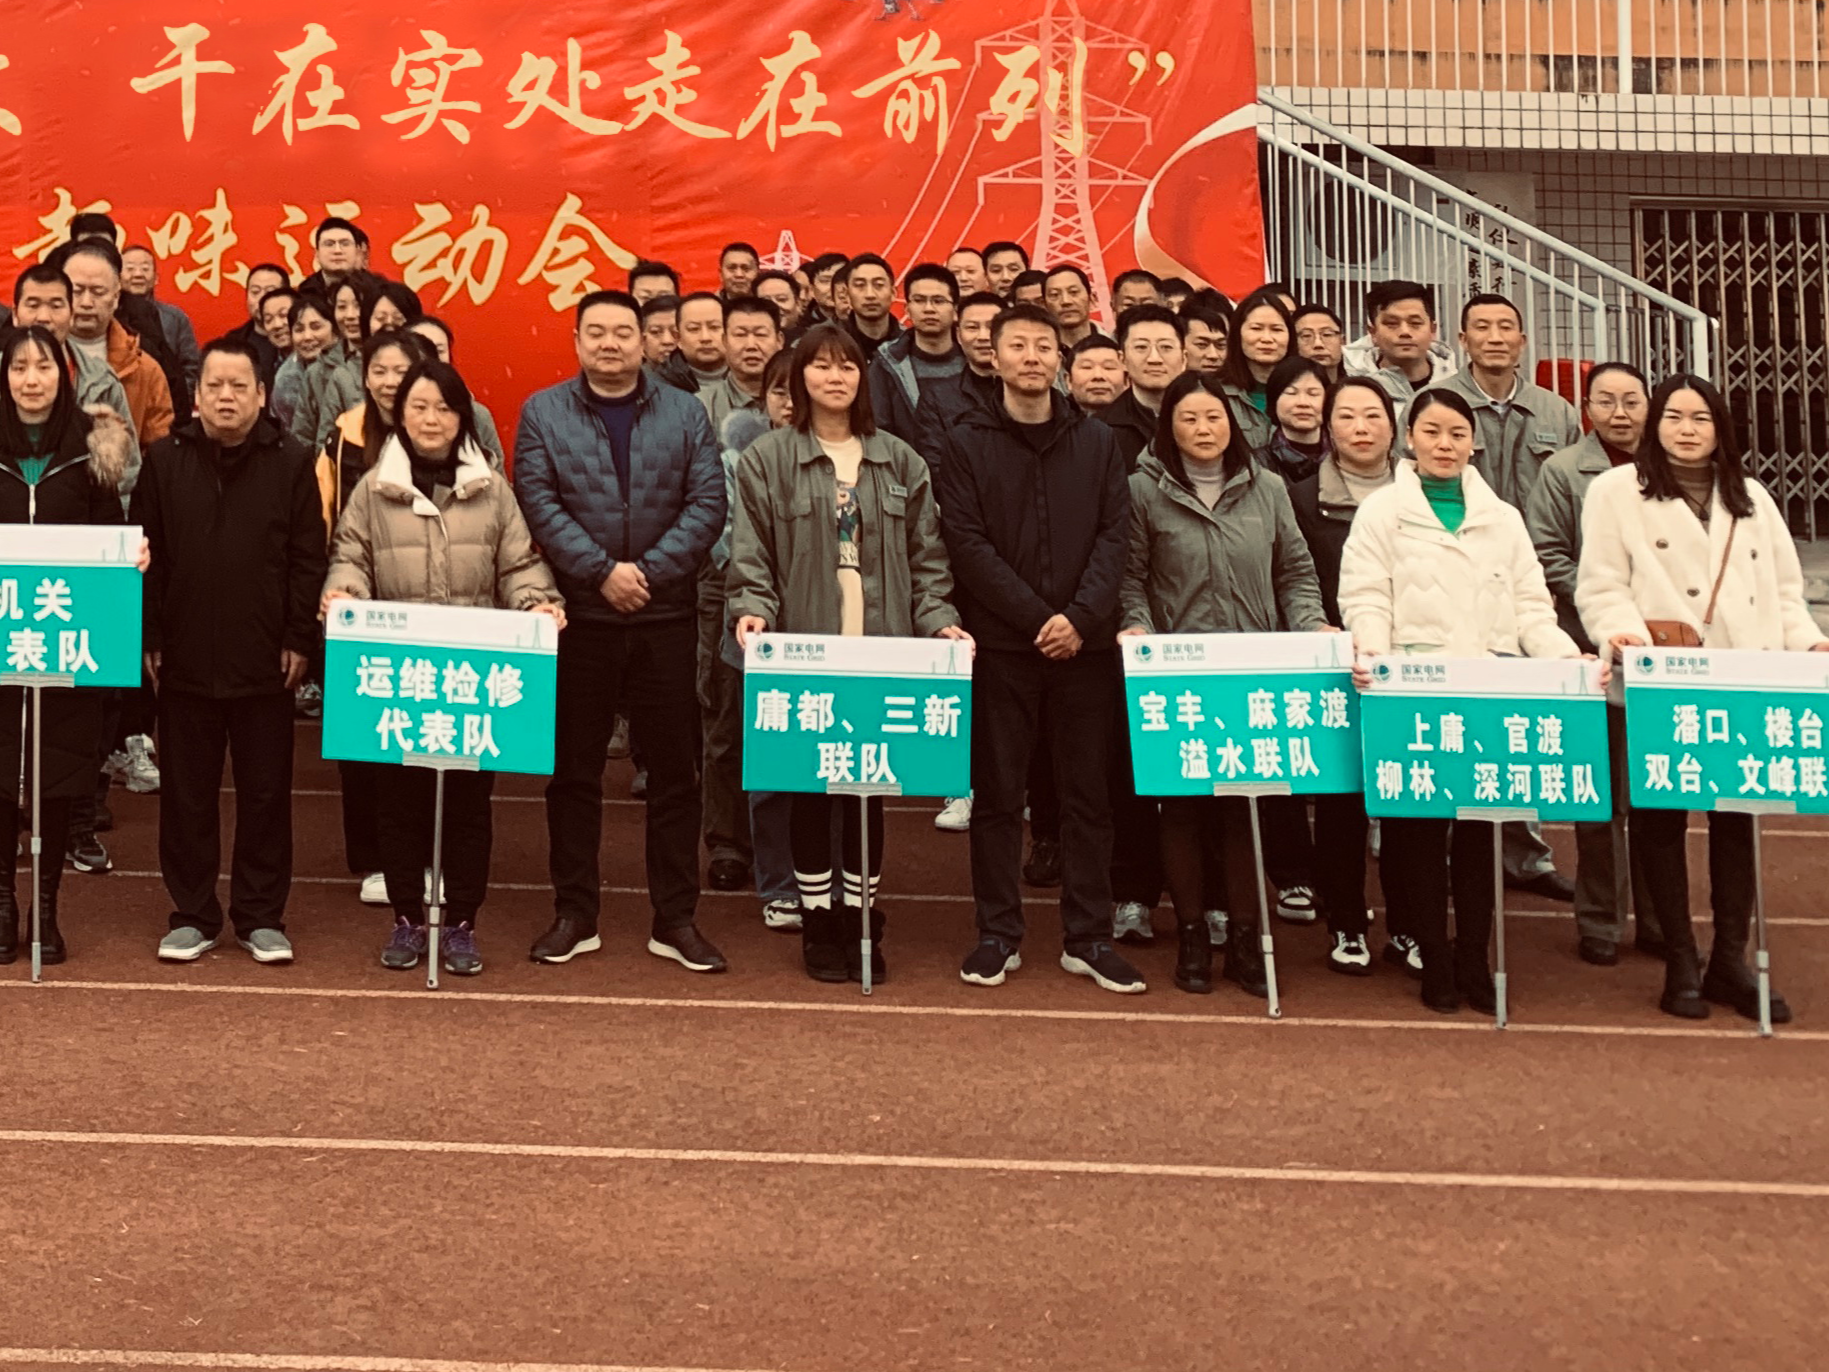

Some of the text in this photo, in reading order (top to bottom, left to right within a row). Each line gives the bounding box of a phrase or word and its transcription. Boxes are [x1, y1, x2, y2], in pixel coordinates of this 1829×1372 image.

[784, 643, 825, 654] 国家电网
[1163, 643, 1204, 654] 国家电网
[1401, 664, 1445, 676] 国家电网
[1665, 656, 1709, 667] 国家电网
[356, 654, 524, 708] 运维检修
[755, 689, 961, 737] 庸都、三新
[1139, 688, 1350, 731] 宝丰、麻家渡
[1673, 704, 1823, 749] 潘口、楼台
[376, 707, 501, 758] 代表队
[1407, 712, 1564, 755] 上庸、官渡
[817, 741, 897, 783] 联队
[1179, 736, 1320, 779] 溢水联队
[1376, 760, 1600, 805] 柳林、深河联队
